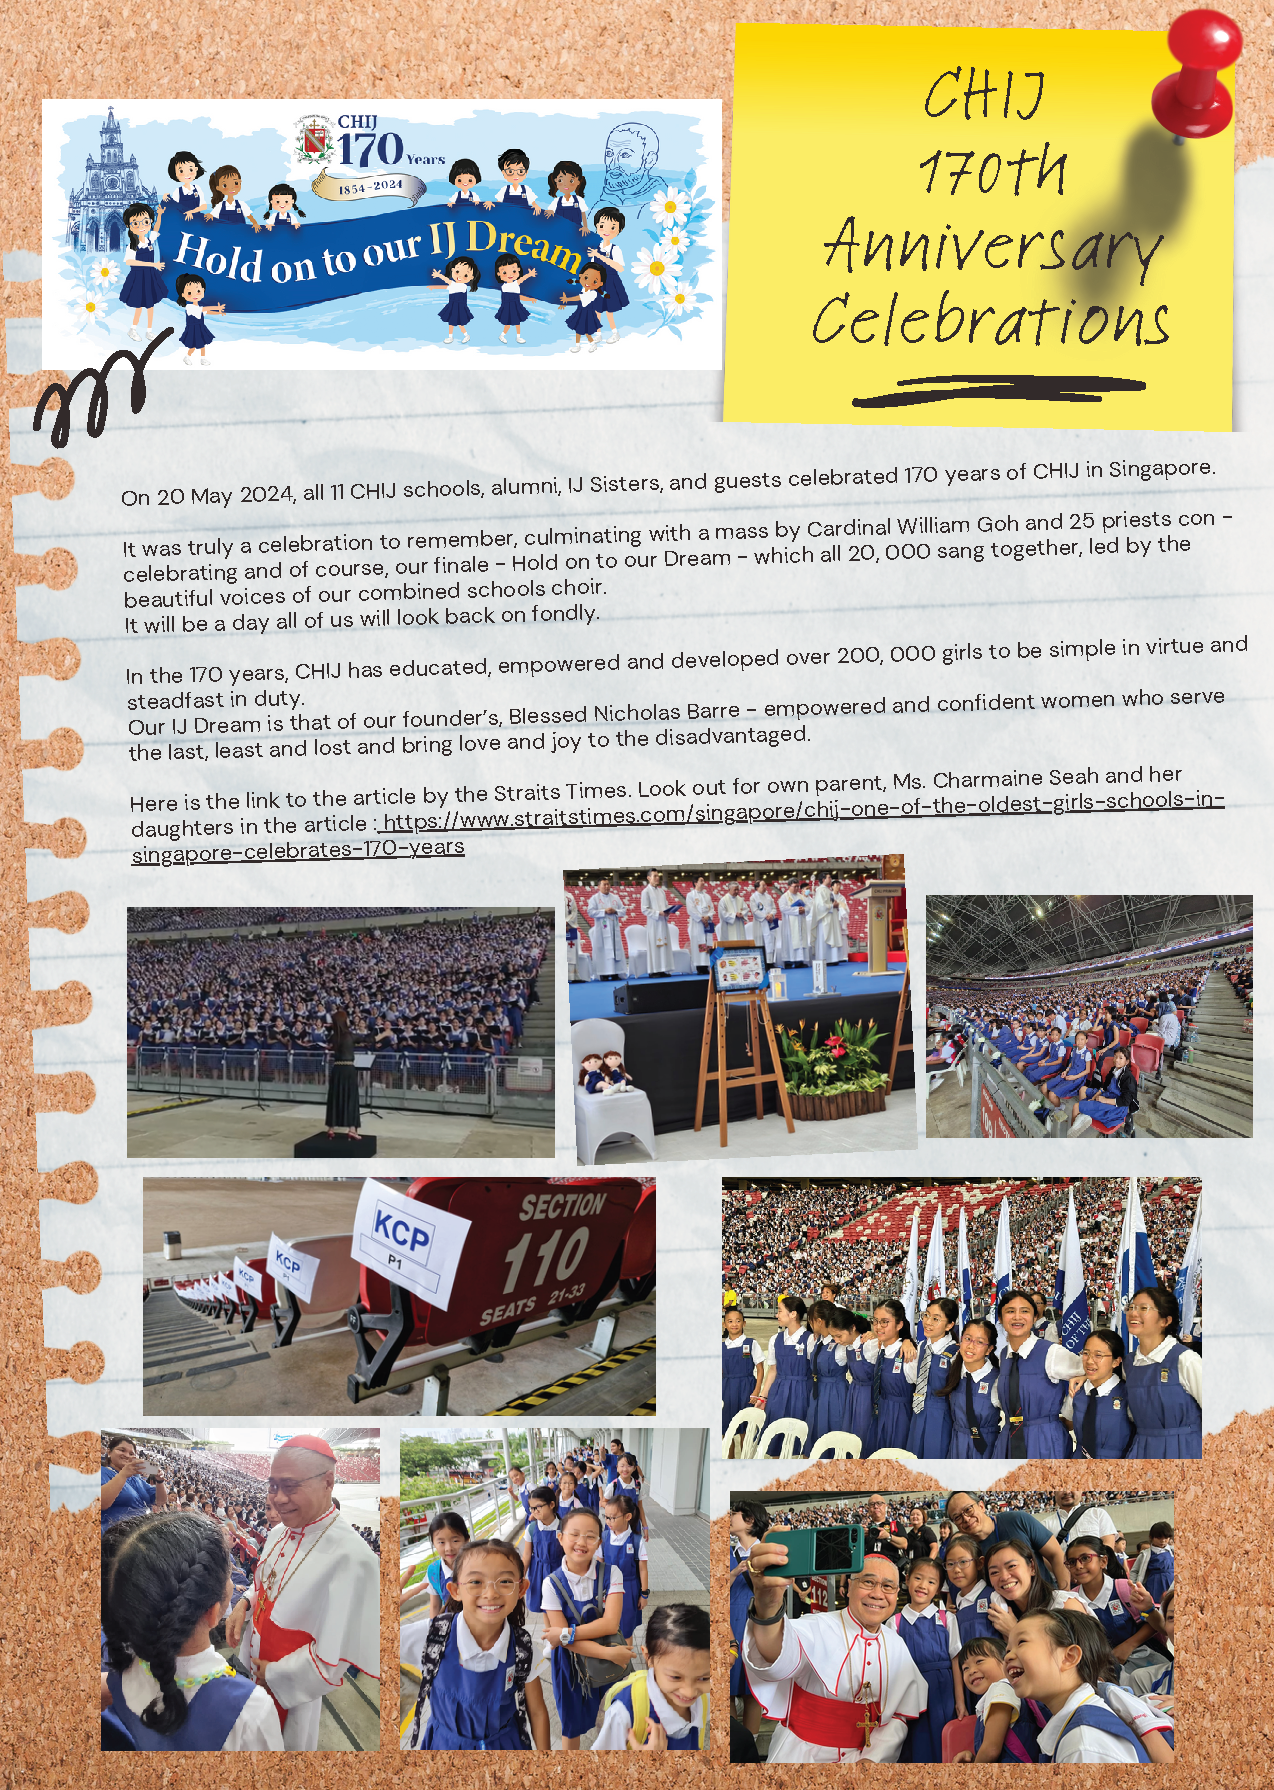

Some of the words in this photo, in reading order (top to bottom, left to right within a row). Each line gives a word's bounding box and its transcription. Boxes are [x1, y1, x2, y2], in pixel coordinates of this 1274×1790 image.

[925, 66, 1044, 120] CHIJ
[338, 114, 378, 131] CHIJ
[337, 132, 404, 168] 170
[406, 153, 446, 165] Years
[920, 142, 1067, 196] 170th
[173, 231, 263, 284] Hold
[271, 258, 315, 284] on
[321, 250, 358, 277] to
[363, 235, 422, 268] our
[428, 221, 456, 260] IJ
[466, 220, 582, 275] Dream
[824, 216, 1164, 286] Anniversary
[813, 290, 1169, 346] Celebrations
[122, 491, 149, 506] On
[158, 489, 184, 505] 20
[192, 488, 232, 508] May
[241, 486, 296, 504] 2024,
[304, 484, 323, 500] all
[331, 484, 343, 500] 11
[351, 483, 395, 499] CHIJ
[404, 480, 484, 498] schools,
[492, 477, 561, 496] alumni,
[569, 477, 582, 493] IJ
[591, 476, 663, 493] Sisters,
[670, 473, 706, 490] and
[715, 473, 781, 493] guests
[789, 467, 897, 486] celebrated
[905, 467, 937, 483] 170
[945, 469, 1000, 486] years
[1007, 463, 1026, 480] of
[1034, 463, 1078, 479] CHIJ
[1087, 461, 1102, 477] in
[1110, 460, 1215, 481] Singapore.
[124, 542, 136, 557] It
[142, 544, 181, 556] was
[188, 538, 233, 558] truly
[241, 542, 251, 553] a
[259, 534, 372, 553] celebration
[380, 535, 400, 549] to
[408, 530, 517, 548] remember,
[525, 526, 641, 547] culminating
[649, 524, 690, 541] with
[699, 529, 709, 540] a
[716, 527, 768, 539] mass
[776, 521, 800, 542] by
[808, 518, 890, 537] Cardinal
[897, 517, 969, 534] William
[978, 515, 1018, 532] Goh
[1026, 513, 1062, 530] and
[1070, 513, 1094, 529] 25
[1103, 511, 1171, 533] priests
[1179, 514, 1214, 526] con
[124, 558, 237, 584] celebrating
[245, 562, 281, 579] and
[290, 561, 308, 577] of
[316, 564, 388, 578] course,
[396, 562, 428, 574] our
[434, 556, 488, 573] finale
[513, 554, 557, 571] Hold
[566, 558, 589, 569] on
[596, 554, 617, 568] to
[625, 556, 657, 567] our
[665, 551, 730, 566] Dream
[754, 546, 813, 564] which
[821, 545, 840, 562] all
[849, 545, 879, 563] 20,
[886, 544, 930, 560] 000
[938, 546, 984, 562] sang
[991, 539, 1082, 561] together,
[1090, 537, 1118, 554] led
[1127, 537, 1151, 557] by
[1158, 535, 1190, 552] the
[127, 669, 142, 684] In
[150, 667, 182, 683] the
[190, 667, 222, 682] 170
[229, 669, 288, 686] years,
[296, 663, 340, 679] CHIJ
[349, 662, 382, 678] has
[390, 658, 491, 677] educated,
[499, 654, 619, 677] empowered
[628, 653, 663, 669] and
[672, 649, 778, 671] developed
[787, 653, 830, 665] over
[838, 647, 883, 665] 200,
[891, 646, 935, 662] 000
[943, 643, 982, 665] girls
[989, 645, 1010, 659] to
[1018, 642, 1041, 658] be
[1050, 639, 1115, 661] simple
[1123, 639, 1139, 655] in
[1146, 638, 1203, 654] virtue
[1211, 635, 1247, 652] and
[128, 691, 224, 709] steadfast
[231, 690, 246, 706] in
[255, 690, 304, 710] duty.
[131, 797, 177, 812] Here
[185, 794, 200, 810] is
[206, 793, 239, 809] the
[247, 792, 280, 808] link
[286, 793, 306, 807] to
[313, 790, 346, 806] the
[354, 788, 415, 805] article
[424, 787, 448, 808] by
[455, 786, 487, 802] the
[495, 784, 560, 801] Straits
[566, 782, 631, 799] Times.
[639, 780, 686, 797] Look
[693, 780, 726, 795] out
[733, 778, 760, 794] for
[768, 781, 808, 793] own
[816, 776, 886, 796] parent,
[894, 773, 925, 789] Ms.
[934, 770, 1042, 788] Charmaine
[1050, 767, 1098, 785] Seah
[1106, 766, 1142, 783] and
[1150, 766, 1182, 782] her
[132, 820, 233, 841] daughters
[241, 818, 257, 834] in
[264, 817, 296, 833] the
[305, 815, 366, 832] article
[131, 840, 465, 867] singapore-celebrates-170-years
[519, 1193, 608, 1222] SECTION
[374, 1209, 430, 1252] KCP
[239, 1268, 254, 1283] KCP
[276, 1249, 301, 1273] KCP
[388, 1254, 402, 1270] P1
[502, 1226, 590, 1295] 110
[479, 1296, 538, 1327] SEATS
[547, 1282, 586, 1306] 21-33
[1062, 1311, 1081, 1336] CHIJ
[1065, 1333, 1079, 1349] OF
[811, 1586, 828, 1607] 112
